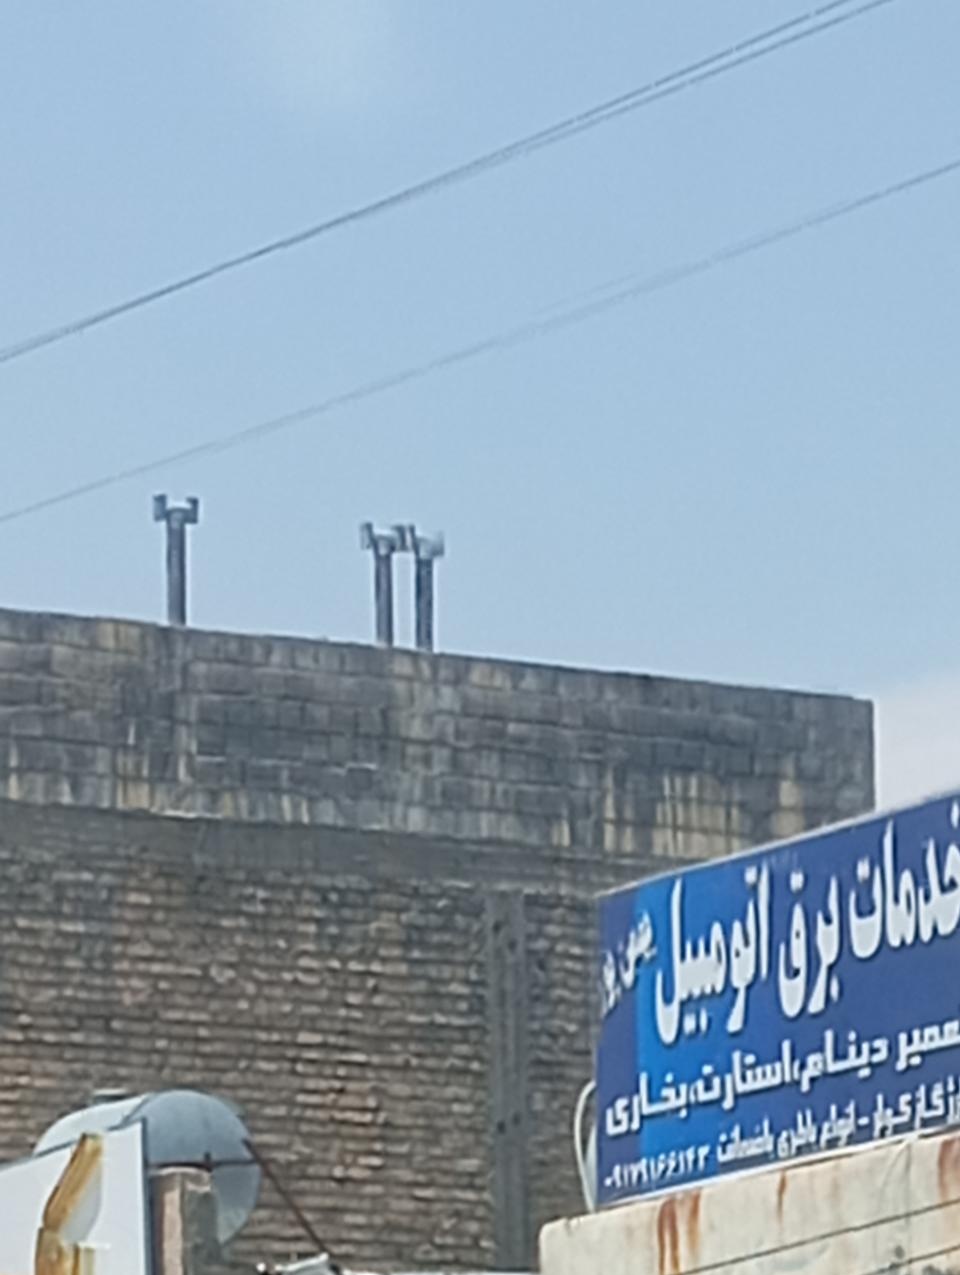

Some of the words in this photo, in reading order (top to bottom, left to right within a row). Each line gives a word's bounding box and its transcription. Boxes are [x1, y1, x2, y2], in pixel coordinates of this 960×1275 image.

[654, 861, 770, 1046] اتومبیل
[777, 862, 841, 1018] برق
[605, 1072, 688, 1136] بخاری
